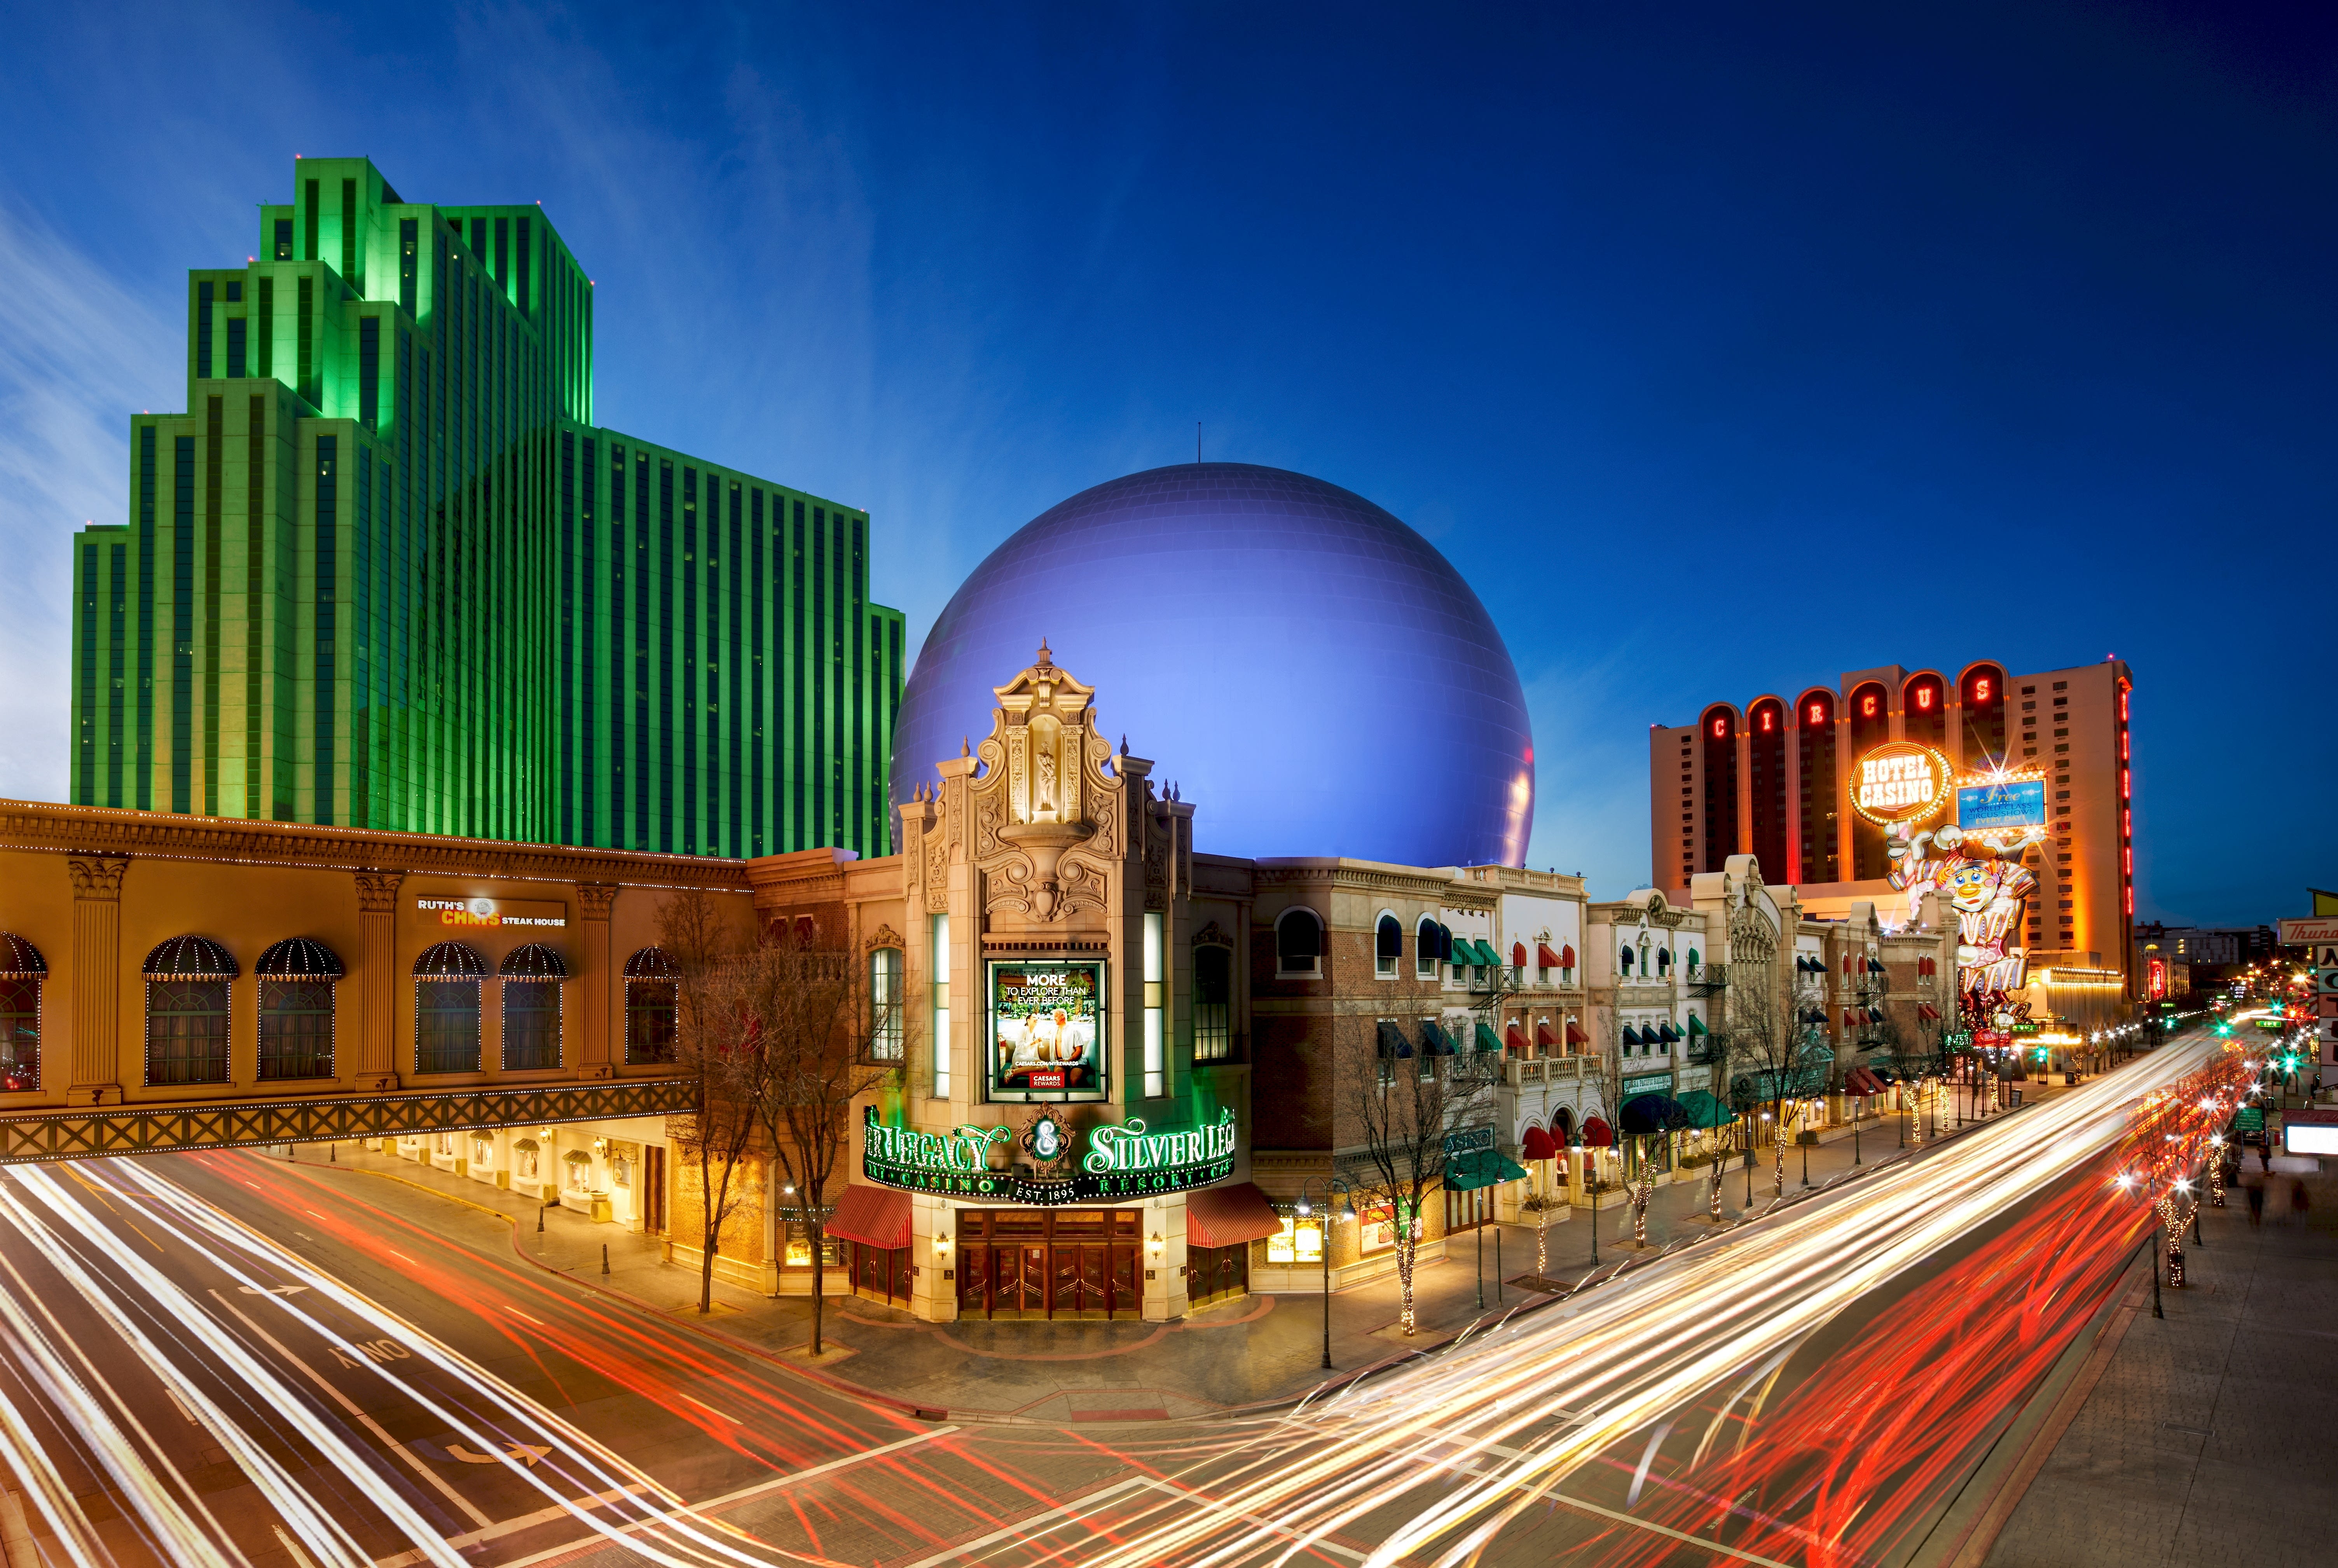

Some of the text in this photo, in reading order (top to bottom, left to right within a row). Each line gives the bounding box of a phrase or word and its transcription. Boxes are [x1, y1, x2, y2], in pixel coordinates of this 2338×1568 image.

[1713, 679, 1990, 739] CIRCUS
[1863, 754, 1931, 784] HOTEL
[1860, 779, 1933, 808] CASINO
[1980, 788, 2020, 804] Free
[1967, 808, 2035, 820] CIRCUS SHOWS
[418, 900, 464, 911] RUTH'S
[502, 917, 533, 925] STEAK
[534, 918, 565, 926] HOUSE
[1027, 974, 1066, 986] MORE
[1006, 987, 1086, 995] TO EXPLORE THAN
[1018, 996, 1075, 1005] EVER BEFORE
[885, 1124, 1011, 1171] LEGACY
[1084, 1116, 1202, 1174] SILVER
[900, 1173, 994, 1192] CASINO
[1100, 1171, 1194, 1192] RESORT
[1016, 1187, 1074, 1200] EST. 1895
[327, 1339, 411, 1369] ONY
